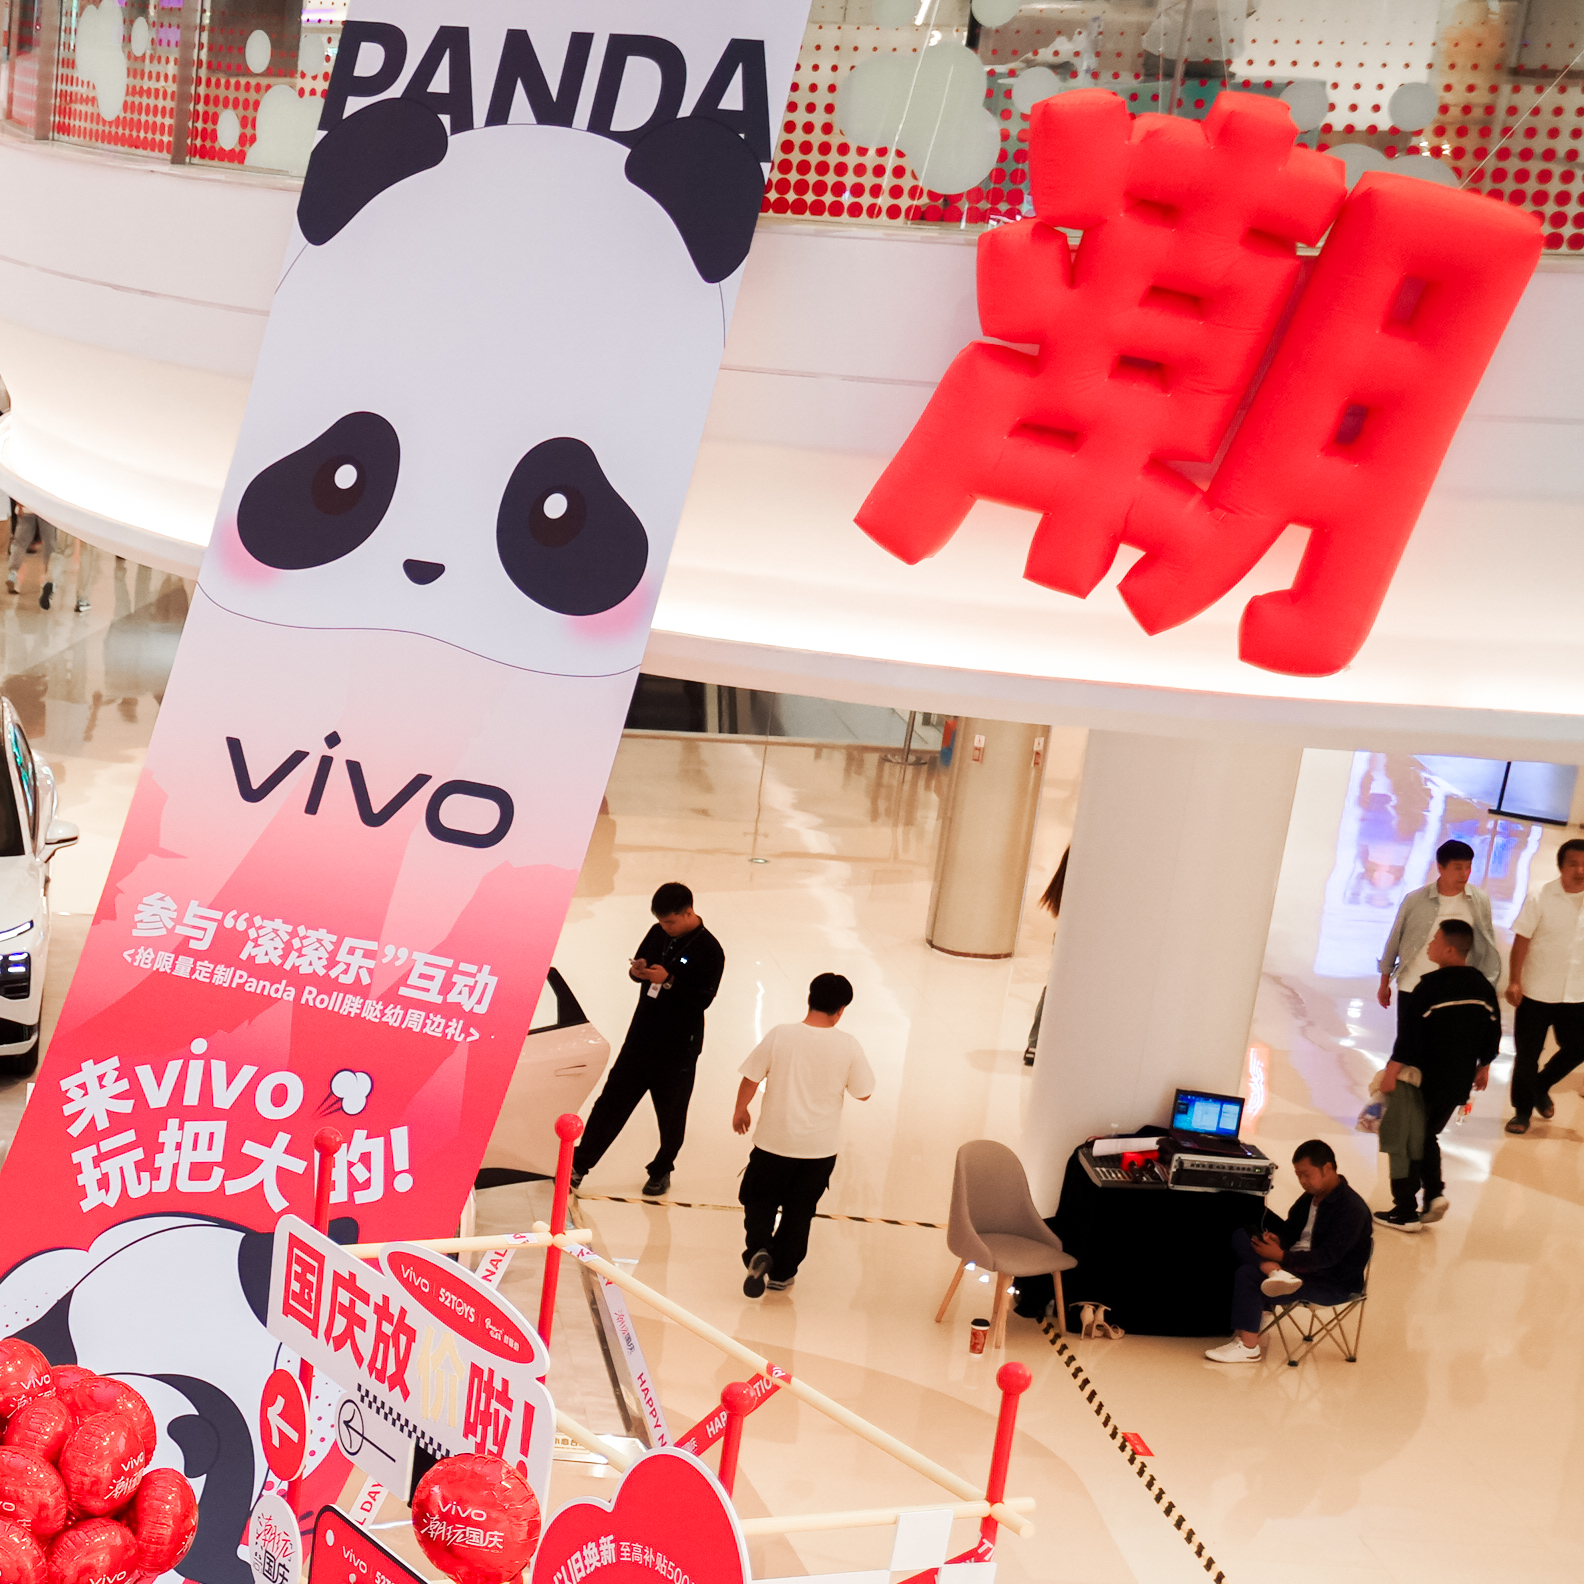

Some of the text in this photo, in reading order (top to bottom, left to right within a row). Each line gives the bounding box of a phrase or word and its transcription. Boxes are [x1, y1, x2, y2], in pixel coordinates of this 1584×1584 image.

[317, 20, 773, 163] PANDA
[225, 731, 515, 849] vivo
[61, 1038, 306, 1141] 来vivo
[400, 1264, 476, 1324] vivo 52TOYS
[20, 1374, 51, 1390] vivo
[637, 1372, 662, 1430] HAPPY
[706, 1410, 727, 1439] HAP
[121, 1451, 145, 1471] vivo
[437, 1500, 488, 1521] vivo
[341, 1545, 368, 1574] vivo
